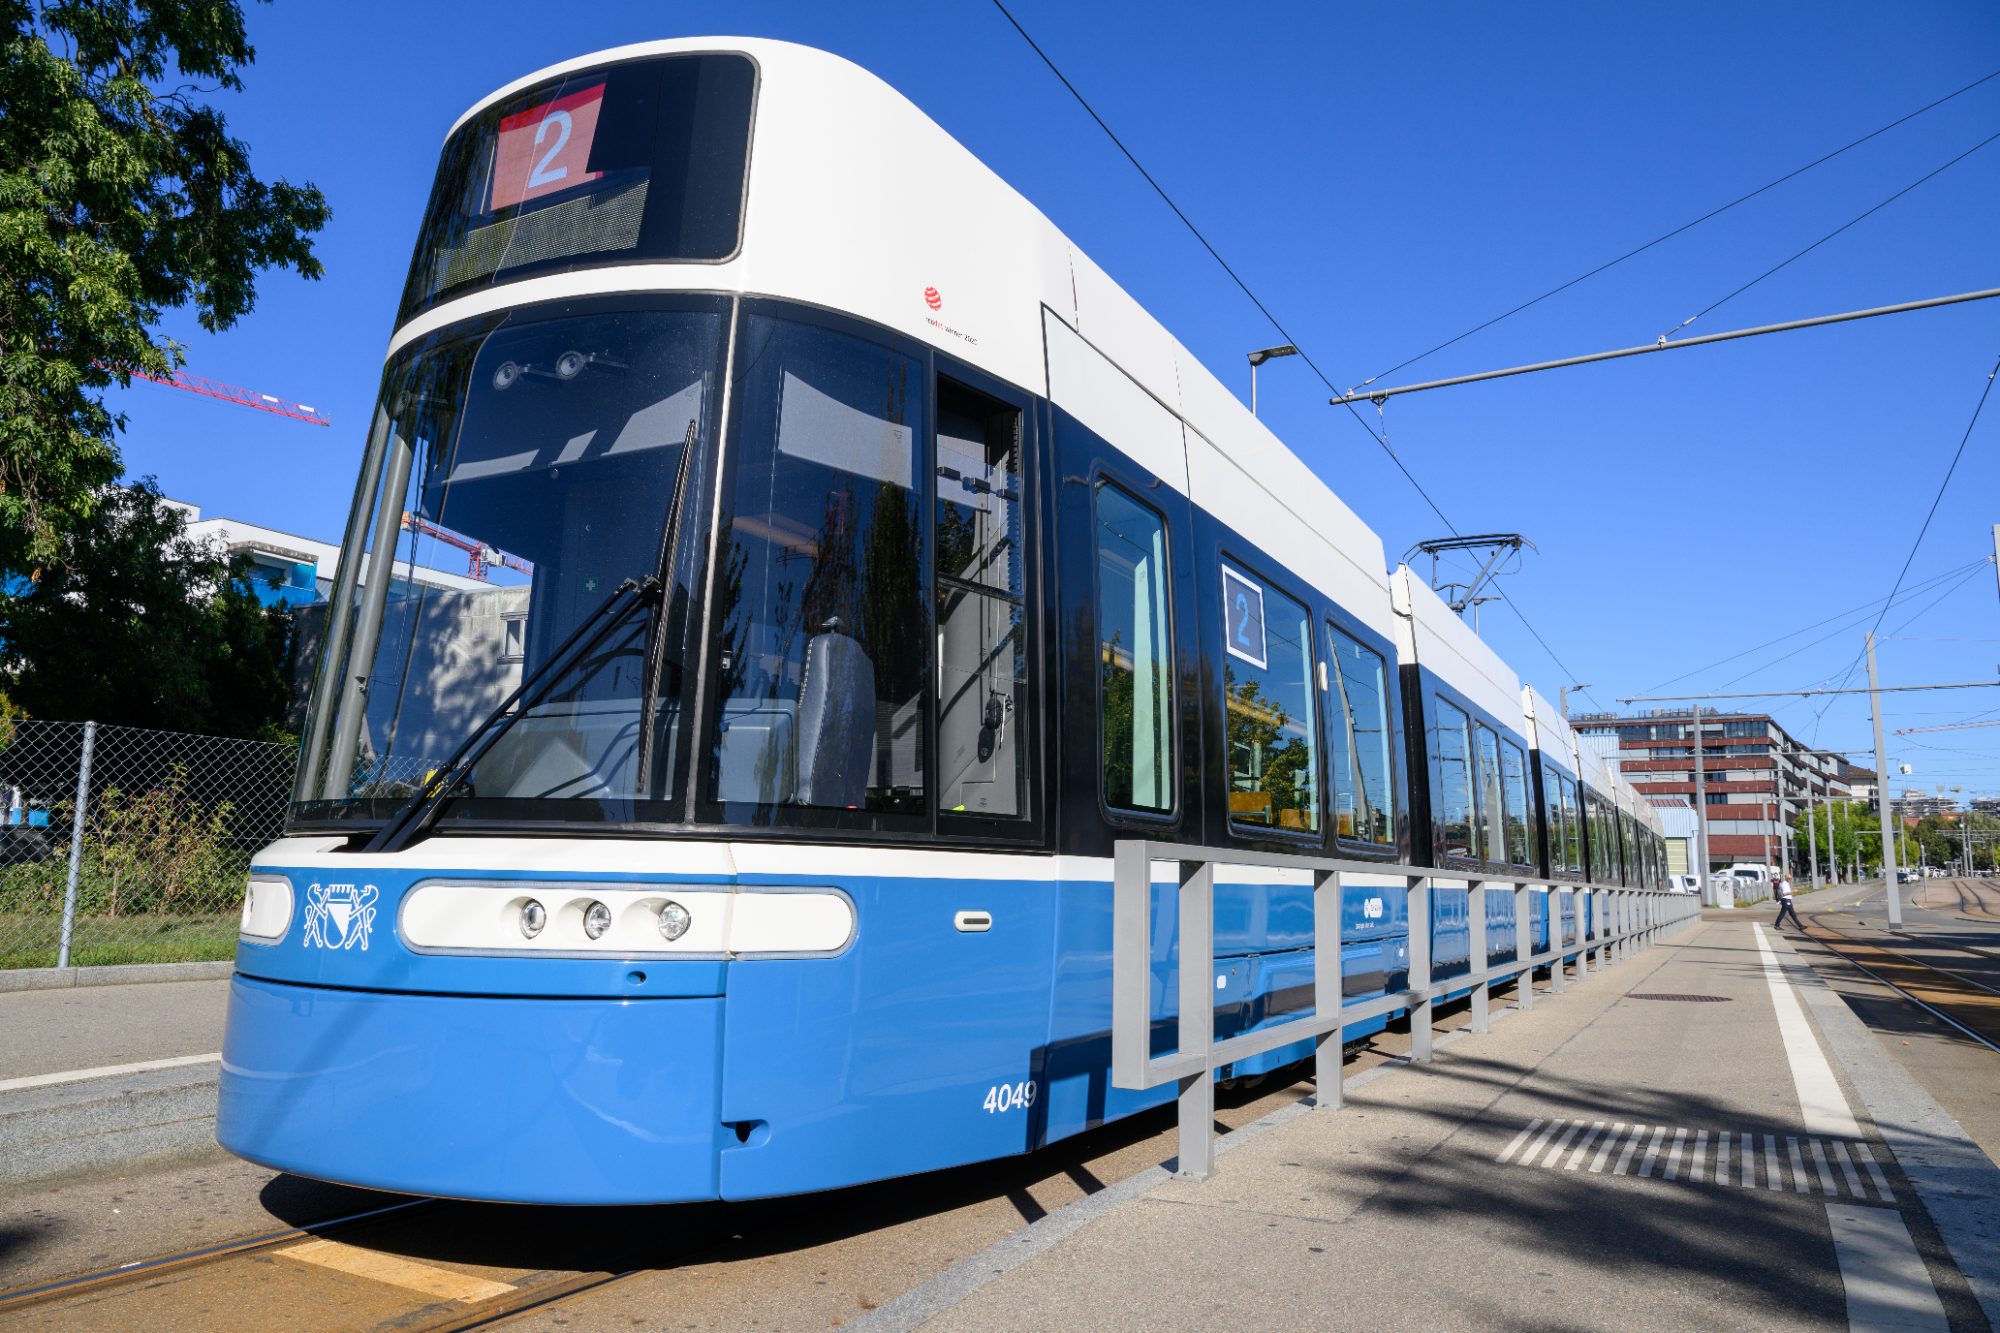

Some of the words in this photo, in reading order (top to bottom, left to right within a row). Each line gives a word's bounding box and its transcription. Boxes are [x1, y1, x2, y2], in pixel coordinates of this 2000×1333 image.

[528, 110, 572, 188] 2
[1236, 593, 1250, 646] 2
[983, 1080, 1037, 1114] 4049
